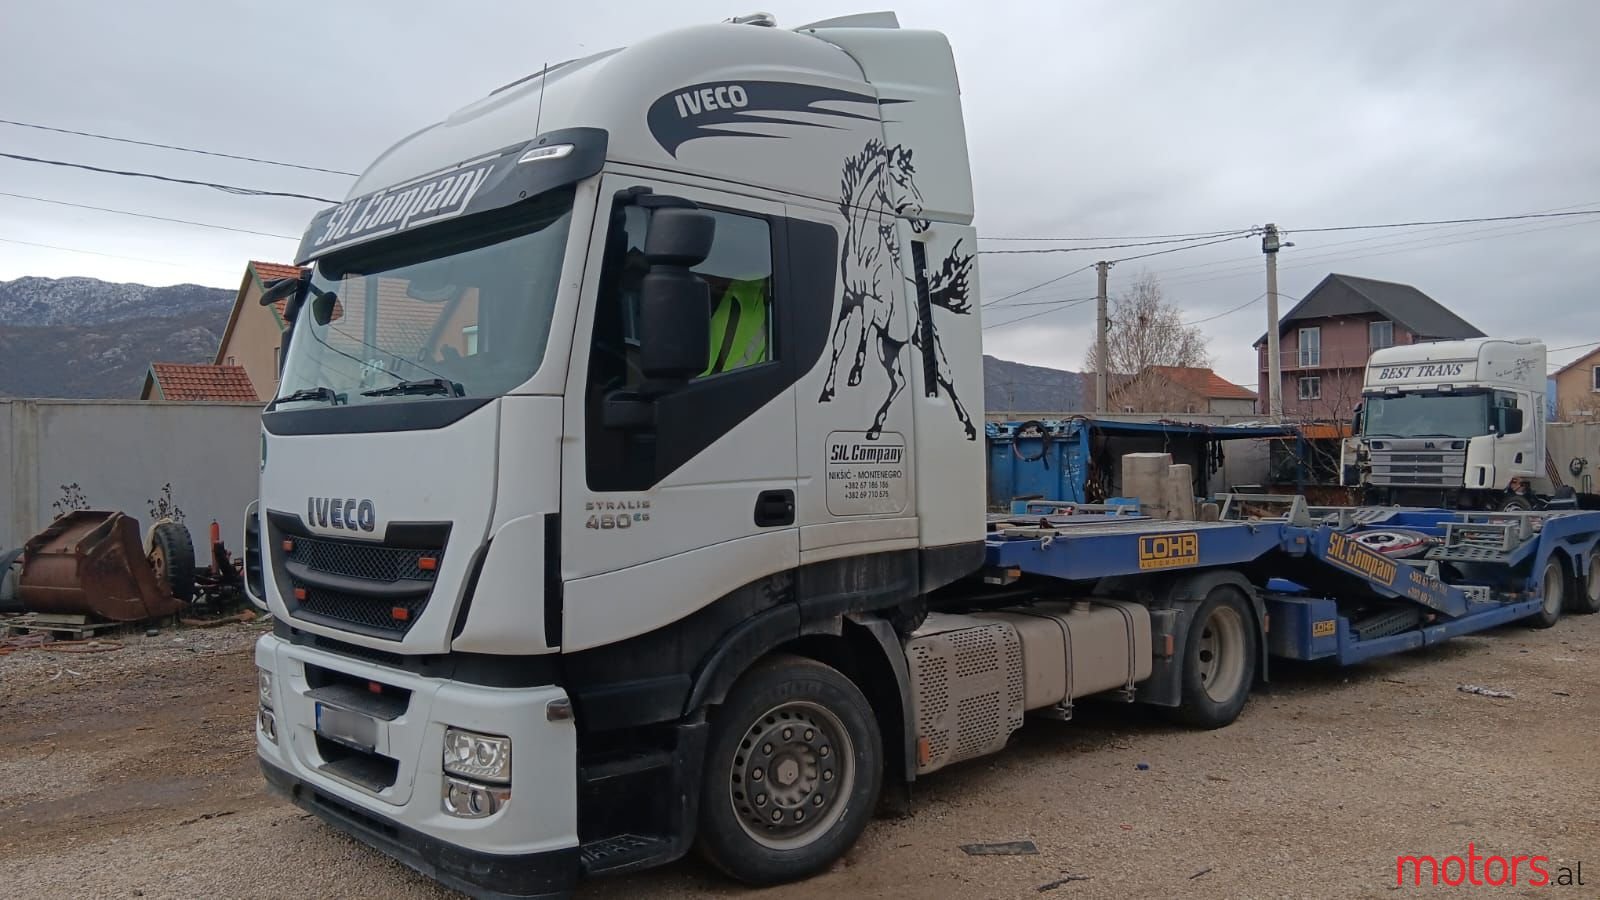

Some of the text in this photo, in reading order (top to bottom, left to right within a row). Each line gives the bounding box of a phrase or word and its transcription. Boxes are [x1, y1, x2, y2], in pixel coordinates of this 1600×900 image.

[674, 85, 748, 118] IVECO
[350, 164, 495, 230] Company
[1379, 363, 1464, 380] BEST TRANS
[852, 444, 903, 464] Company
[858, 470, 902, 479] MONTENEGRO
[307, 496, 376, 532] IVECO
[585, 501, 651, 511] STRALIS
[585, 513, 632, 530] 480
[1141, 535, 1196, 559] LOHR
[1347, 540, 1397, 586] Company
